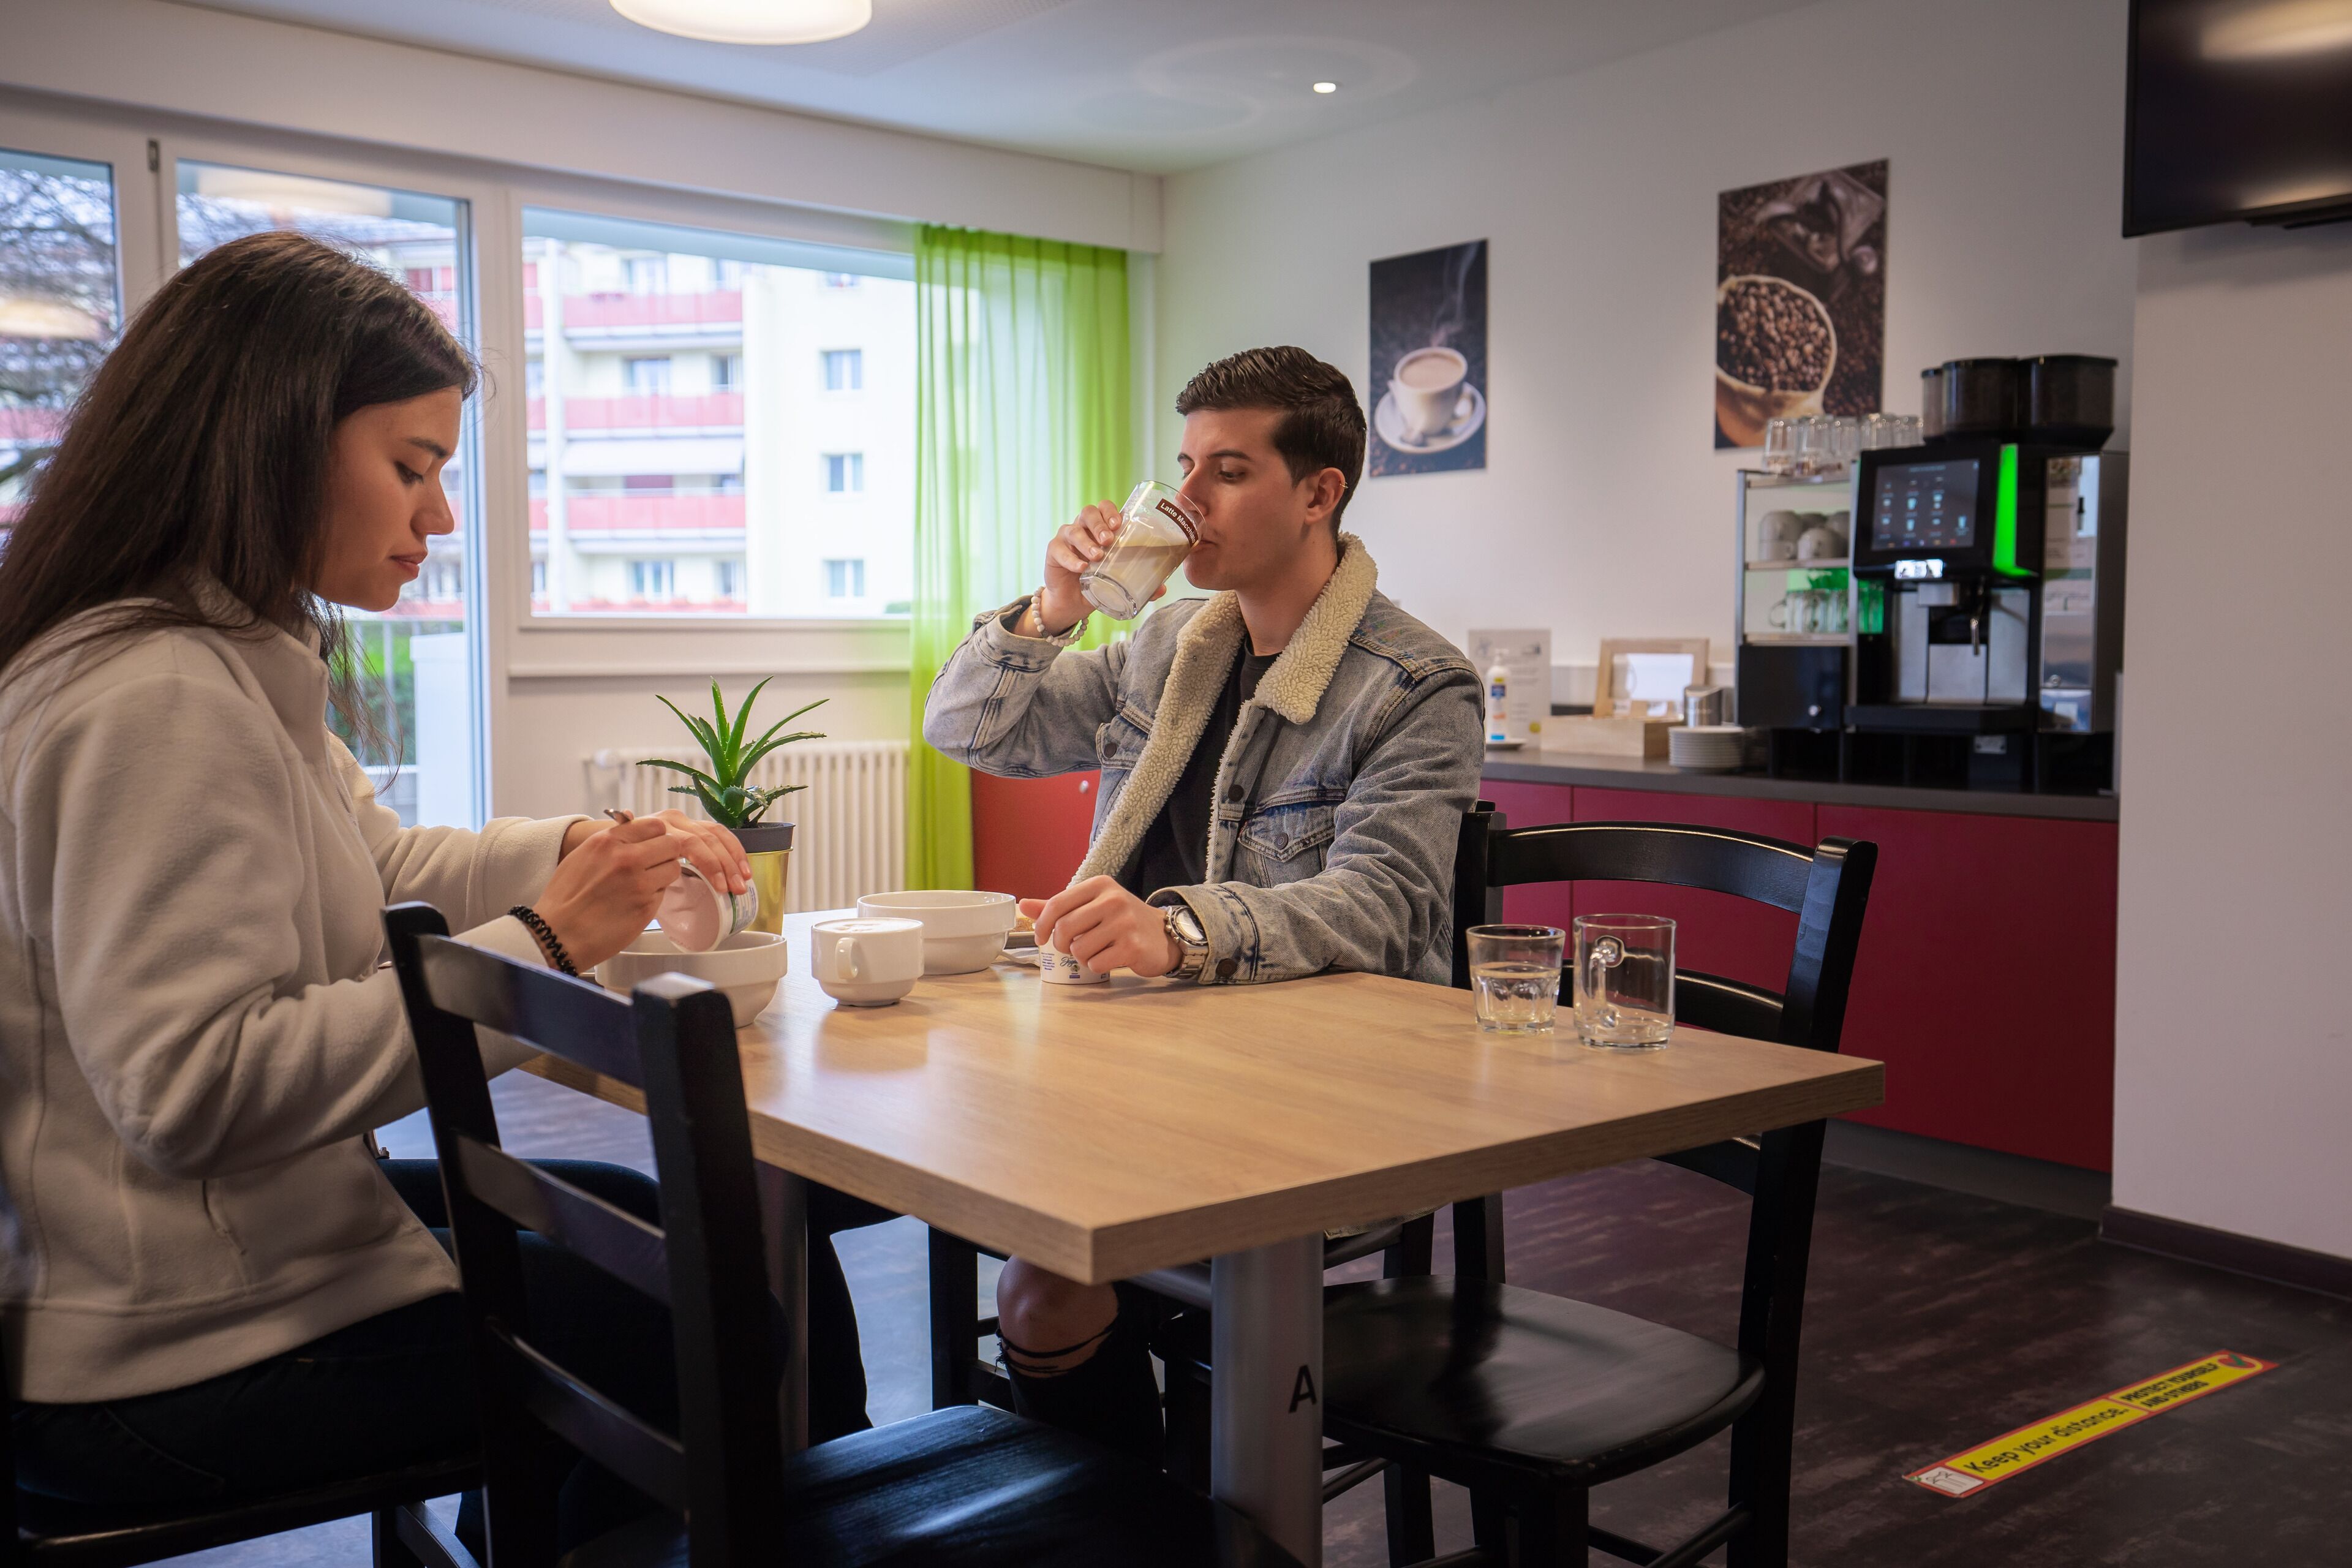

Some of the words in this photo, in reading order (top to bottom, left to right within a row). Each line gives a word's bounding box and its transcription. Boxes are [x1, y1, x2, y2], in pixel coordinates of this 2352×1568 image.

[1160, 502, 1177, 518] Latte
[1177, 514, 1196, 543] Macchiato
[1289, 1365, 1317, 1414] A
[2140, 1392, 2169, 1408] AND
[2164, 1380, 2209, 1398] OTHERS
[1963, 1451, 2021, 1473] Keep
[2013, 1434, 2057, 1455] your
